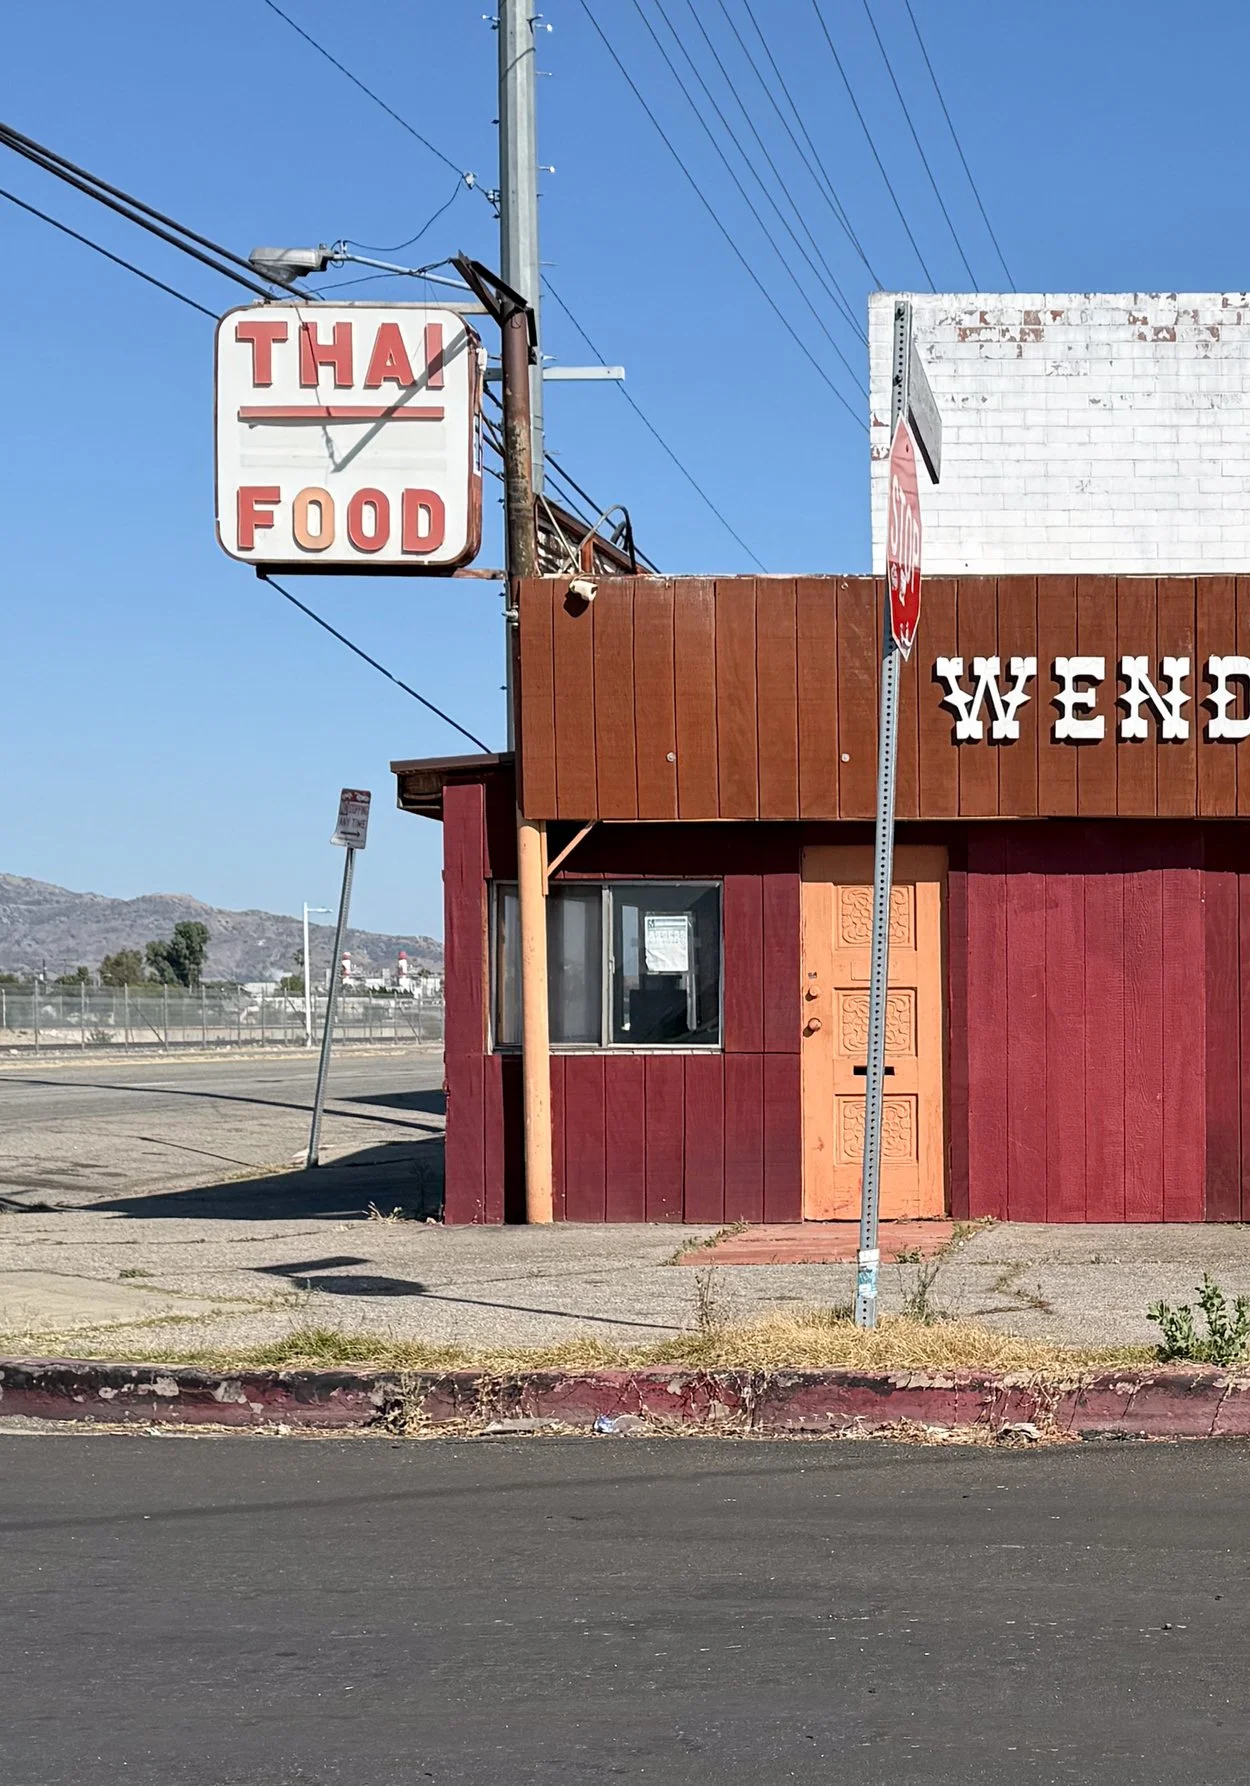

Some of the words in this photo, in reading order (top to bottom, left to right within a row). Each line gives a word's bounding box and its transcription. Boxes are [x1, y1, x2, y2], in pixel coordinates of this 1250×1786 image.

[236, 321, 444, 387] THAI
[237, 486, 446, 553] FOOD
[890, 475, 919, 594] STOP
